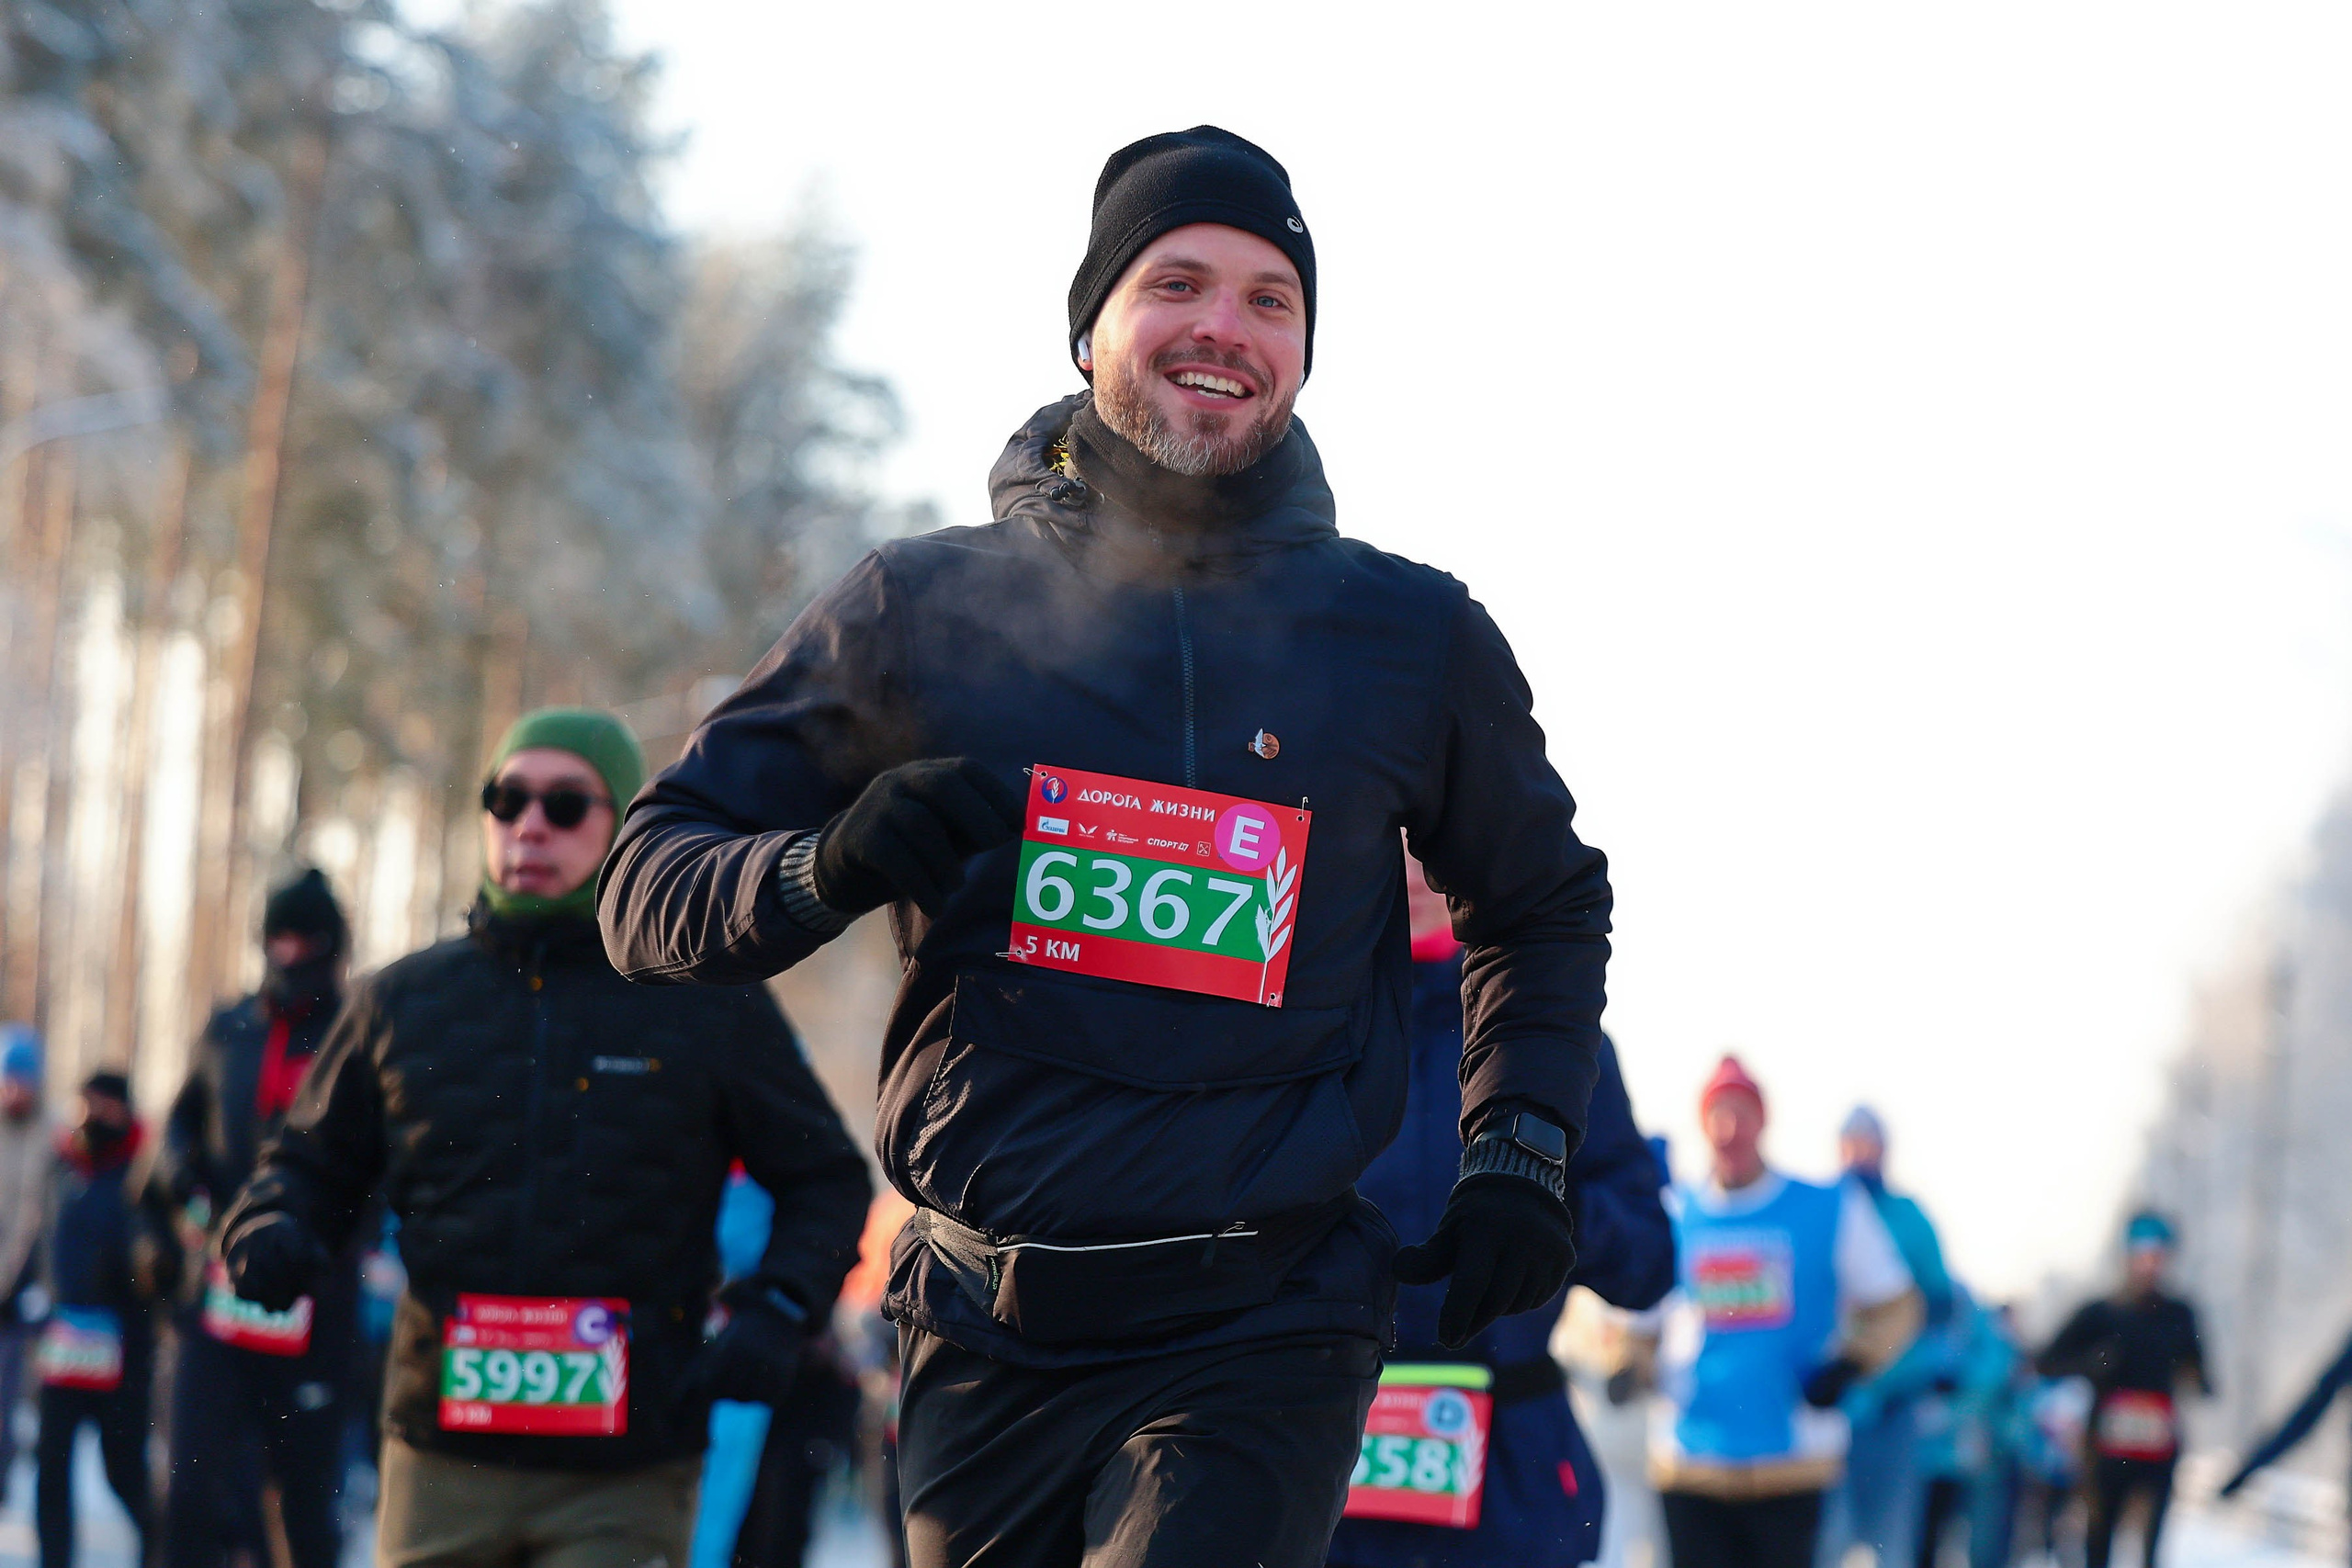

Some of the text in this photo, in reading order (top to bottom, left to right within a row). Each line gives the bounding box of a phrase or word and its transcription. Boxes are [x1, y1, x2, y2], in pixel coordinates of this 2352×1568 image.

[1077, 788, 1215, 822] ДОРОГА ЖИЗНИ
[1229, 815, 1265, 860] E
[1025, 851, 1254, 946] 6367
[1025, 935, 1038, 954] 5
[451, 1347, 597, 1405] 5997
